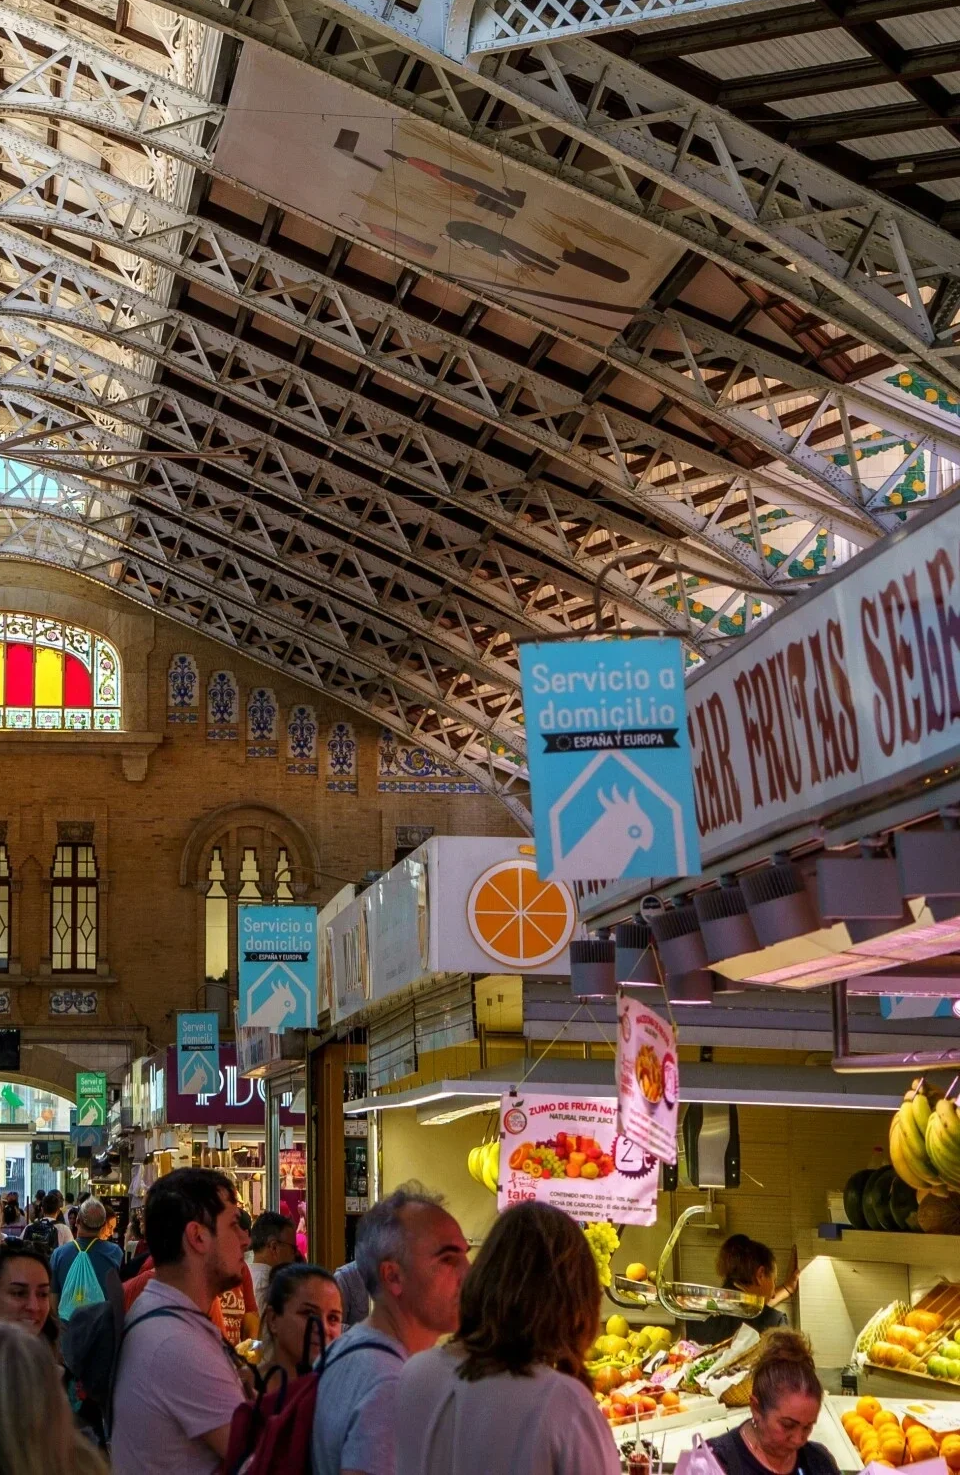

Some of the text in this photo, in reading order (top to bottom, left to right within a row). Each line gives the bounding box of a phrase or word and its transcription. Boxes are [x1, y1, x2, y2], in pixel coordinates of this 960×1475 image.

[531, 661, 676, 694] Servicio a
[733, 618, 860, 810] FRUTAS
[860, 545, 960, 757] SELE
[539, 696, 676, 730] domicilio
[574, 732, 665, 749] ESPAÑA Y EUROPA
[243, 917, 313, 933] Servicio a
[245, 935, 312, 951] domicilio
[258, 953, 278, 961] ESPAÑA
[182, 1021, 213, 1032] Servei a
[182, 1033, 213, 1045] domicili
[529, 1102, 618, 1116] ZUMO DE FRUTA NAT
[549, 1113, 614, 1125] NATURAL FRUIT JUICE
[621, 1138, 634, 1162] 2
[508, 1189, 536, 1200] take
